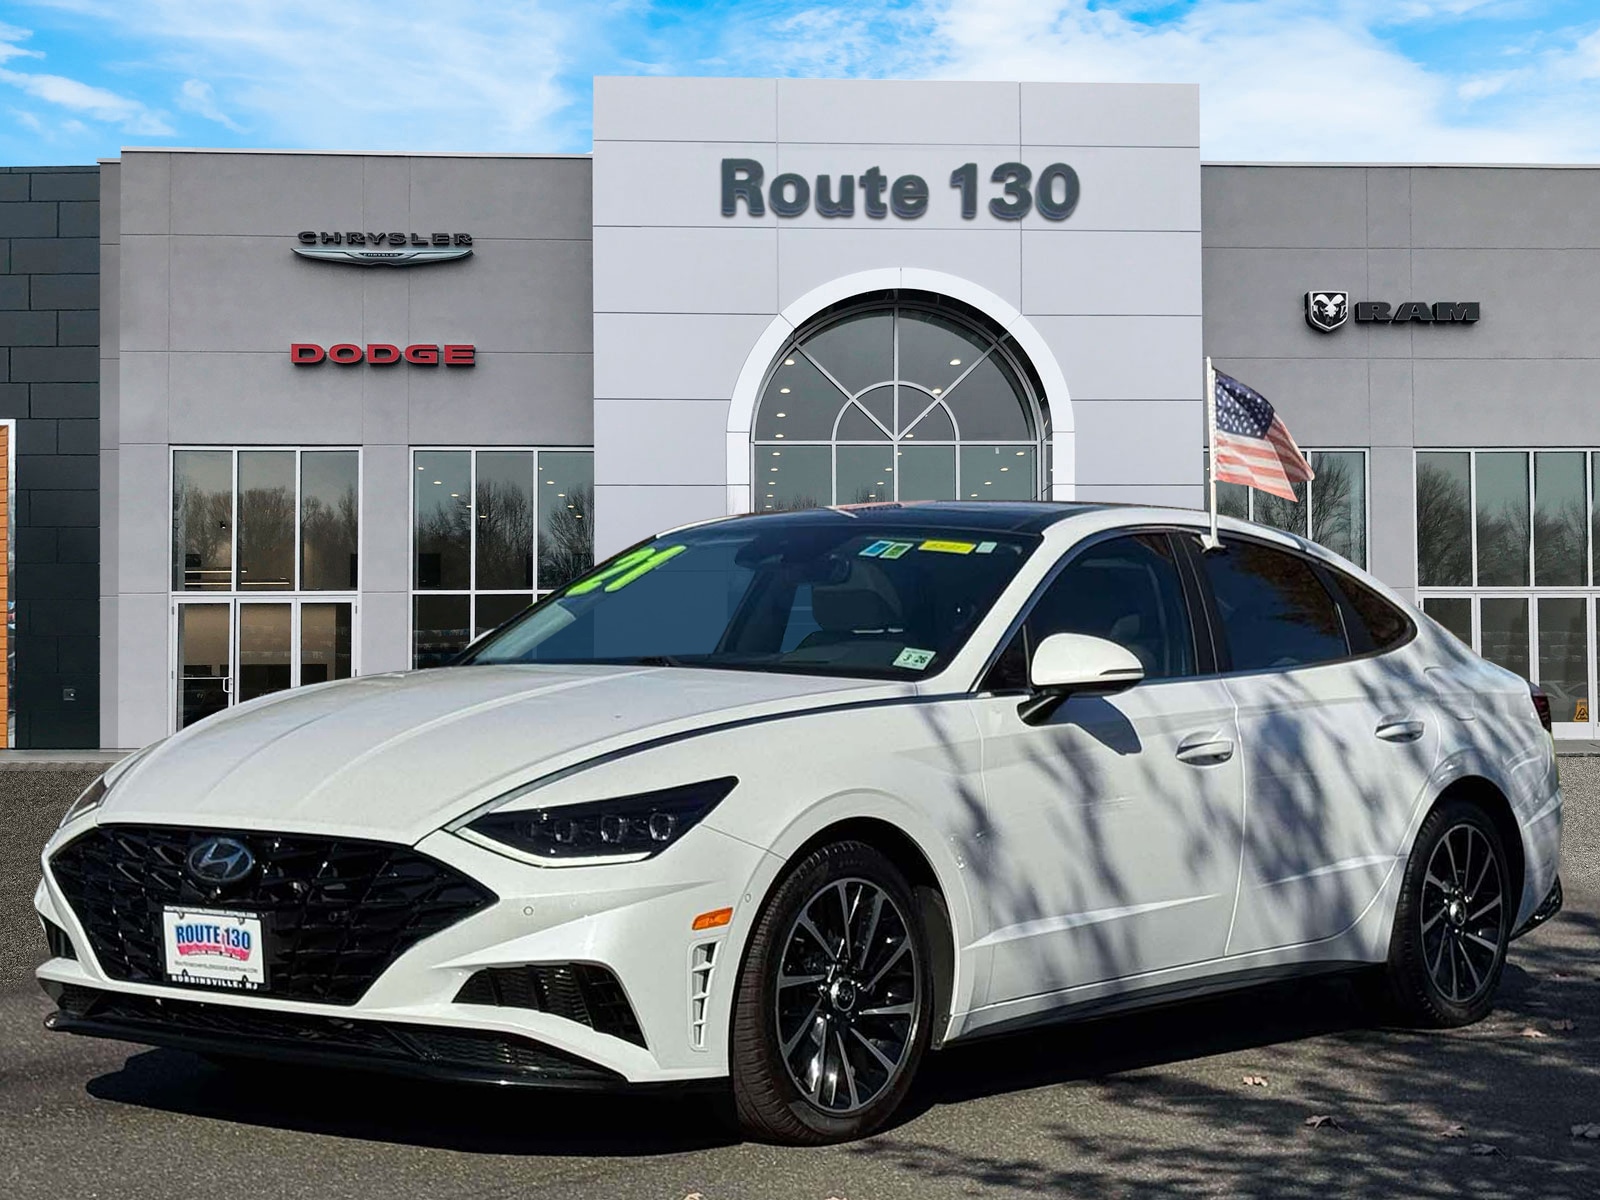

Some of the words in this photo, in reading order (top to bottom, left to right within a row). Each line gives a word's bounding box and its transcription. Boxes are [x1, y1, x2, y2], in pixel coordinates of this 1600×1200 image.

[720, 158, 930, 218] Route
[950, 161, 1081, 221] 130
[297, 231, 473, 246] CHRYSLER
[1354, 301, 1481, 324] RAM
[290, 343, 476, 365] DODGE
[175, 924, 221, 945] ROUTE
[224, 927, 251, 951] 130
